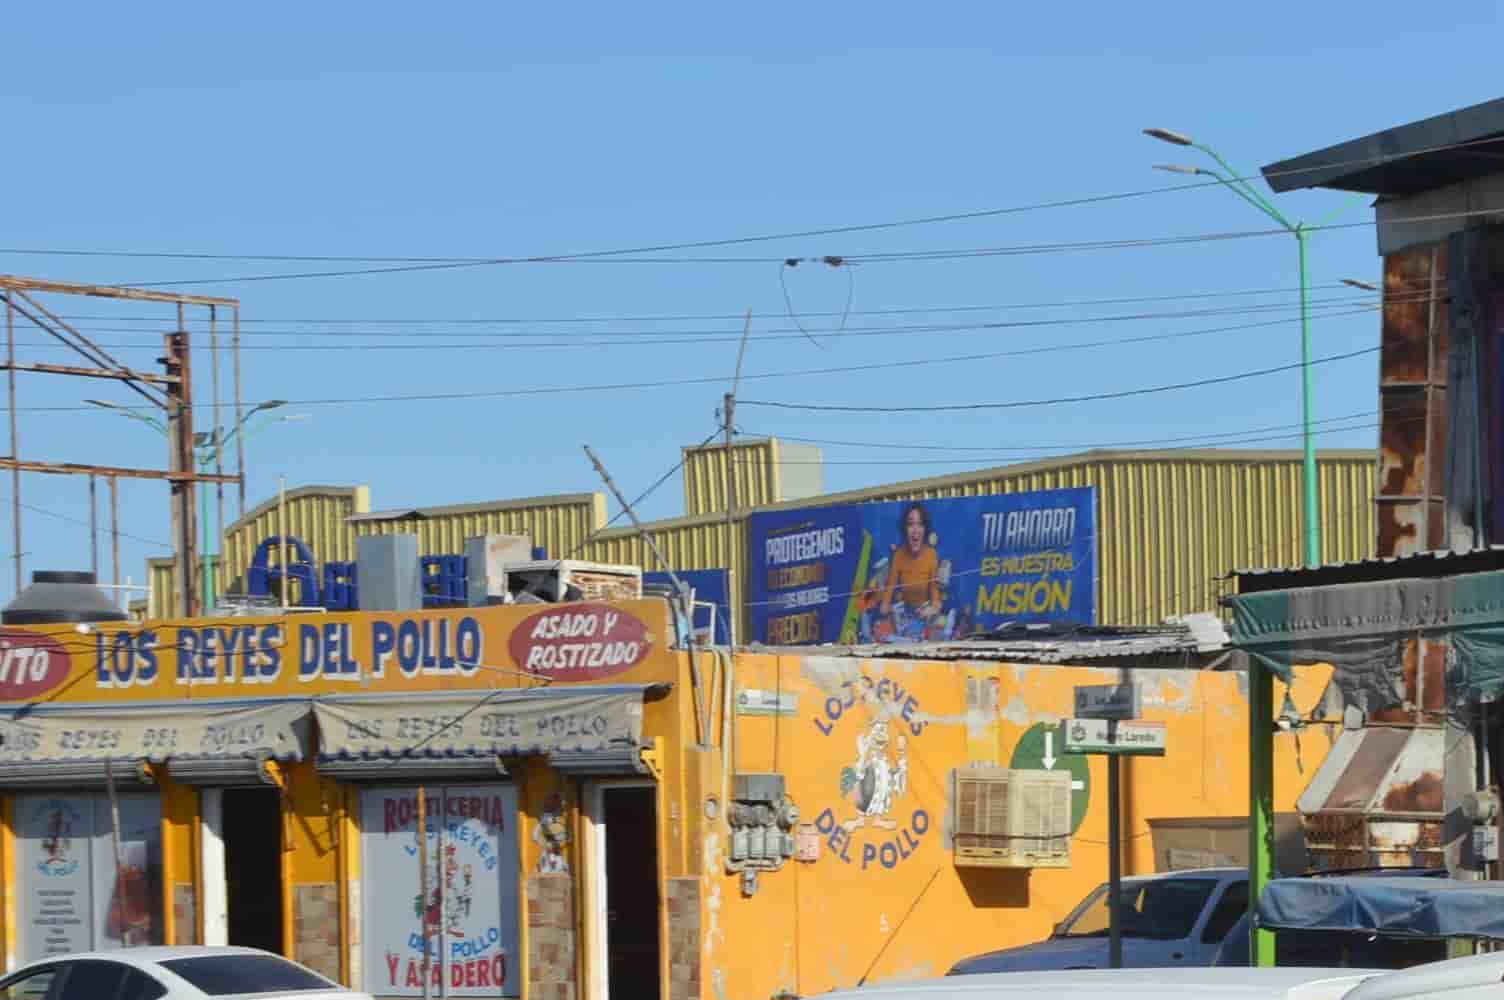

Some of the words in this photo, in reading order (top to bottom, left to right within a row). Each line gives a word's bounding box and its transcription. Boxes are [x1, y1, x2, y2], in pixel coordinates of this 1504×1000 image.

[765, 525, 844, 565] PROTEGEMOS
[982, 512, 1004, 552] TU
[1006, 506, 1076, 550] AHORRO
[980, 556, 1000, 577] ES
[1001, 552, 1073, 575] NUESTRA
[975, 573, 1072, 616] MISIÓN
[531, 611, 597, 640] ASADO
[600, 612, 619, 636] Y
[96, 630, 158, 688] LOS
[176, 624, 281, 685] REYES
[298, 622, 361, 682] DEL
[371, 616, 483, 680] POLLO
[527, 641, 640, 671] ROSTIZADO
[813, 680, 855, 737] LOS
[814, 807, 852, 865] DEL
[861, 809, 929, 871] POLLO
[452, 927, 498, 958] POLLO
[386, 953, 400, 987] Y
[405, 953, 507, 988] AADERO
